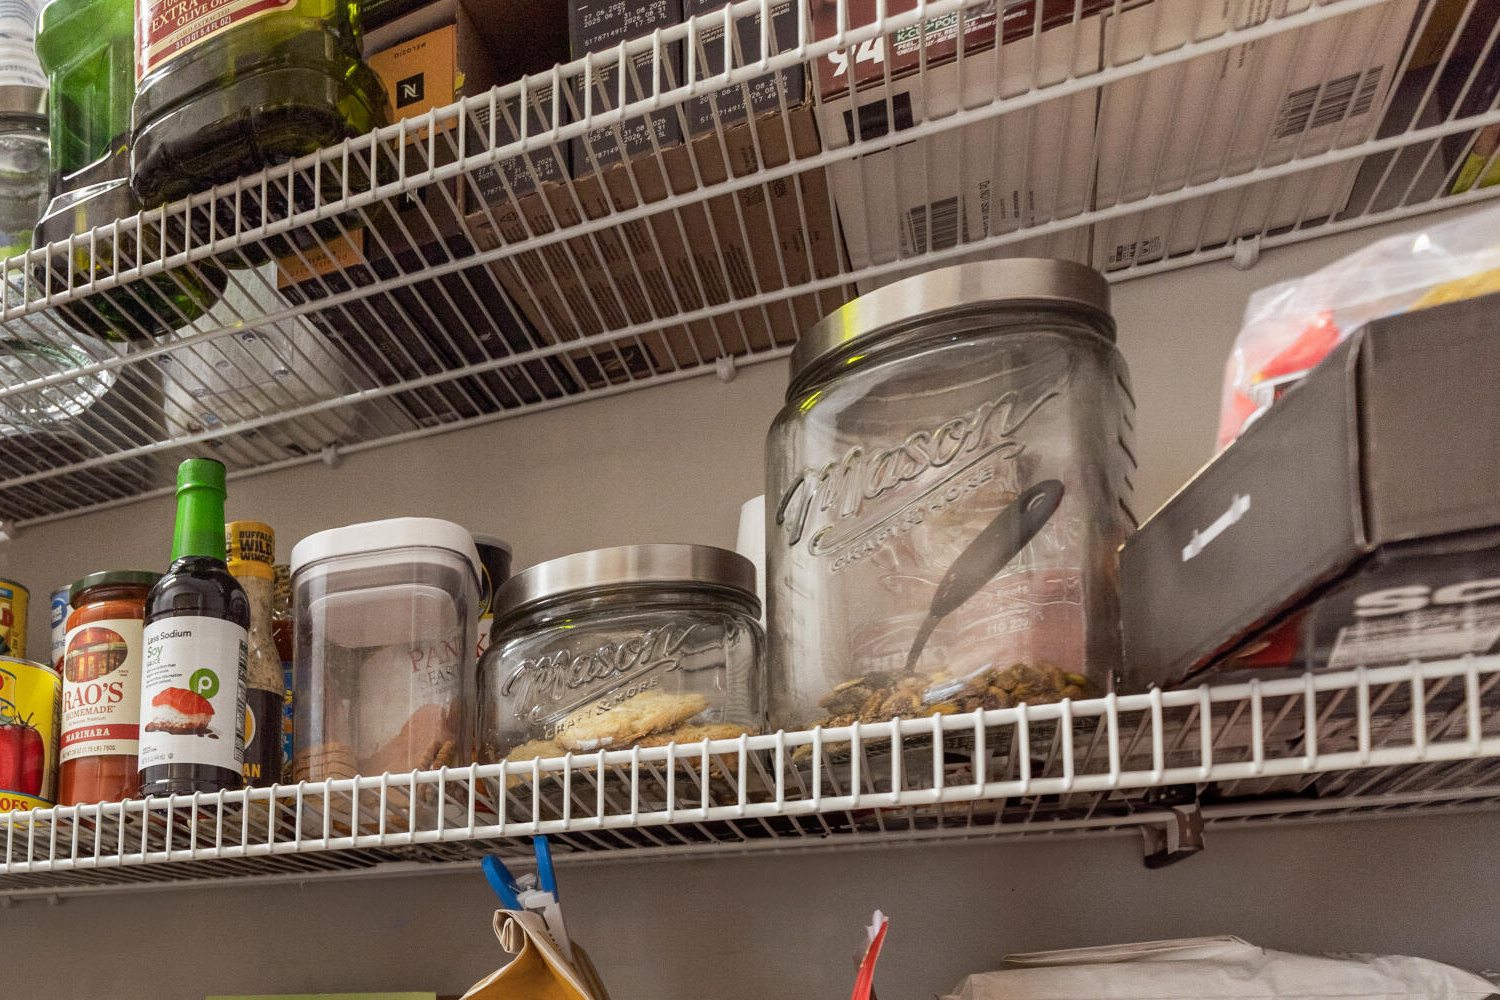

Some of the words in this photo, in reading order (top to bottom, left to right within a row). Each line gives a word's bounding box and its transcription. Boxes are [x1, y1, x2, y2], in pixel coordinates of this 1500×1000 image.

[152, 0, 198, 33] EXTRA
[177, 3, 208, 27] OLIVE
[775, 392, 1058, 548] Mason
[239, 531, 273, 542] BUFFALO
[240, 540, 272, 556] WILD
[147, 636, 159, 645] Less
[160, 629, 192, 640] Sodium
[147, 645, 163, 658] Soy
[502, 622, 699, 716] Mason
[64, 682, 123, 713] RAO'S
[66, 706, 113, 720] HOMEMADE
[545, 709, 593, 739] CRAFT
[613, 677, 659, 707] MORE
[66, 727, 110, 743] MARINARA
